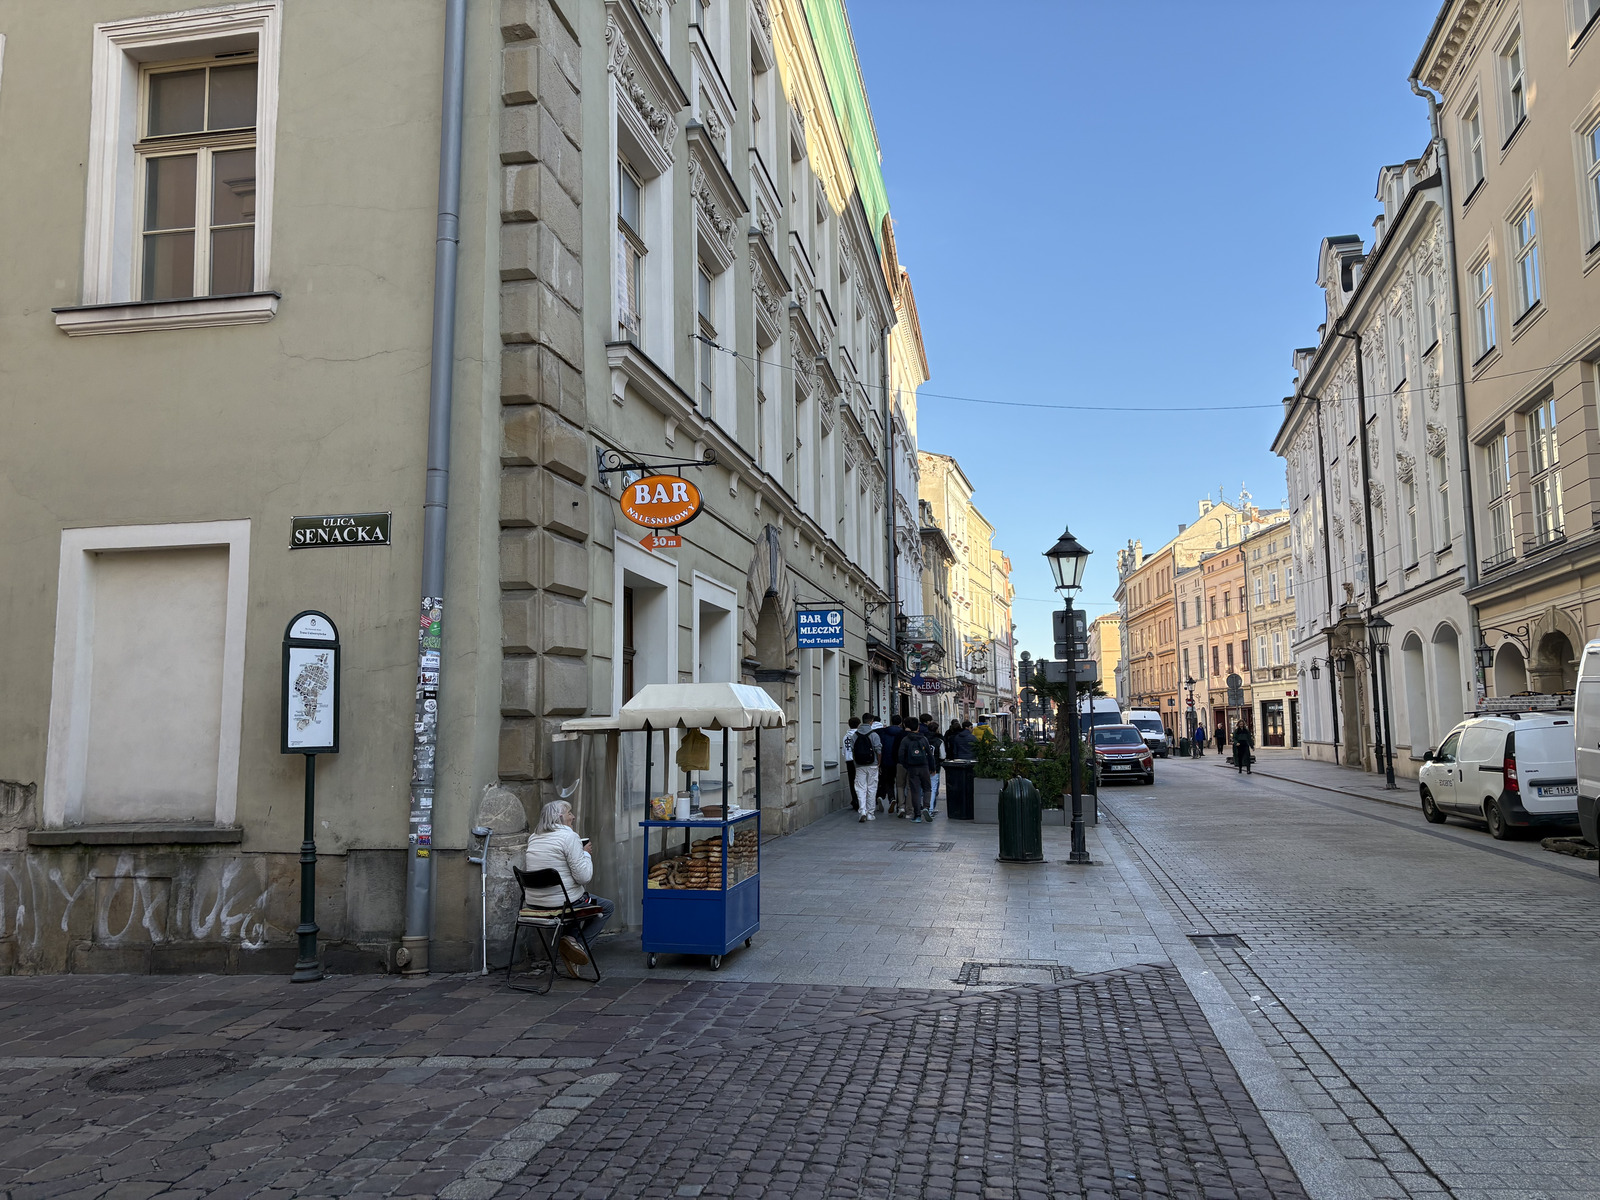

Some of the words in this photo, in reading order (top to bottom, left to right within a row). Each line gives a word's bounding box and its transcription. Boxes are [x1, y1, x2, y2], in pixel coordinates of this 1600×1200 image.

[634, 482, 690, 505] BAR
[626, 503, 695, 525] NALEŚNIKOWY
[323, 518, 356, 526] ULICA
[294, 526, 385, 544] SENACKA
[652, 537, 667, 547] 30
[800, 614, 822, 624] BAR
[800, 626, 841, 635] MLECZNY
[1543, 787, 1554, 795] WE
